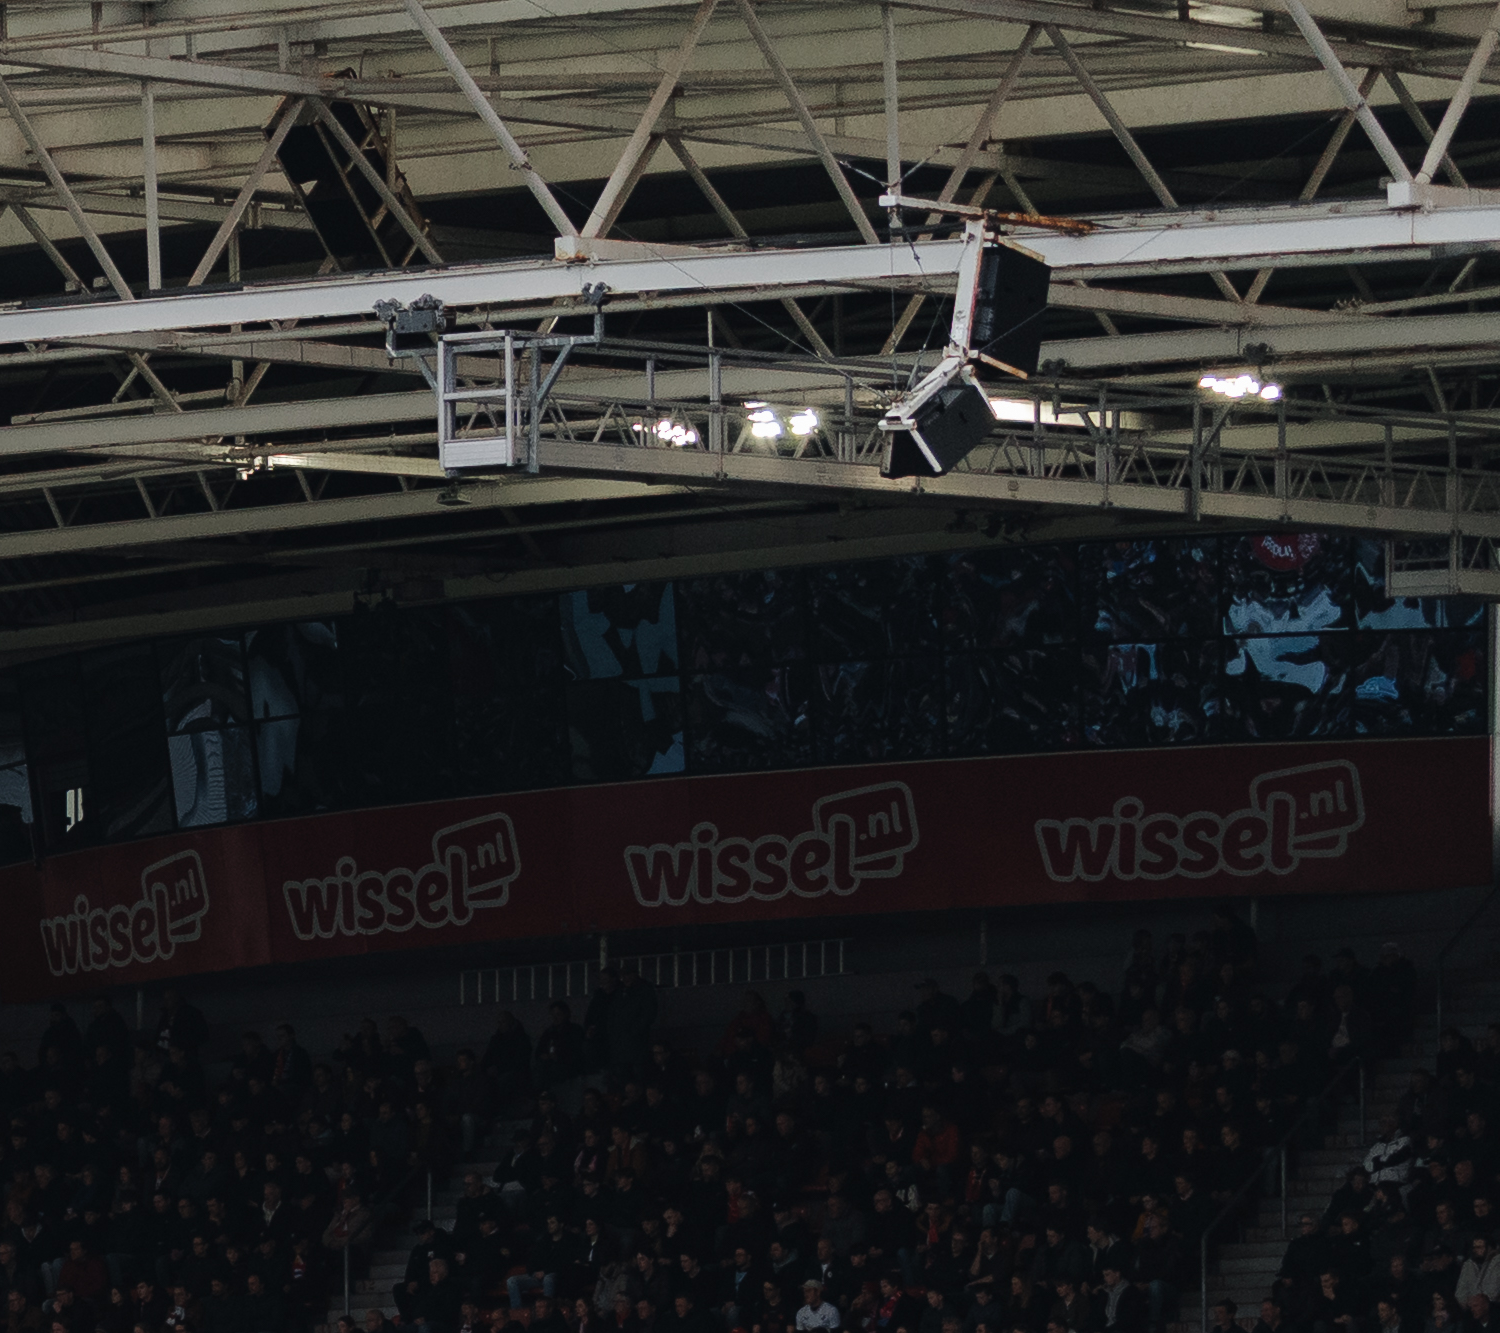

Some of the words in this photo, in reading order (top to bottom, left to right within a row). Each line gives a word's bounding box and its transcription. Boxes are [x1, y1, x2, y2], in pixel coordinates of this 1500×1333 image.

[284, 822, 512, 939] wissel.nl
[626, 792, 908, 907] wissel.nl
[1038, 770, 1356, 885] wissel.nl
[41, 864, 202, 977] wissel.nl
